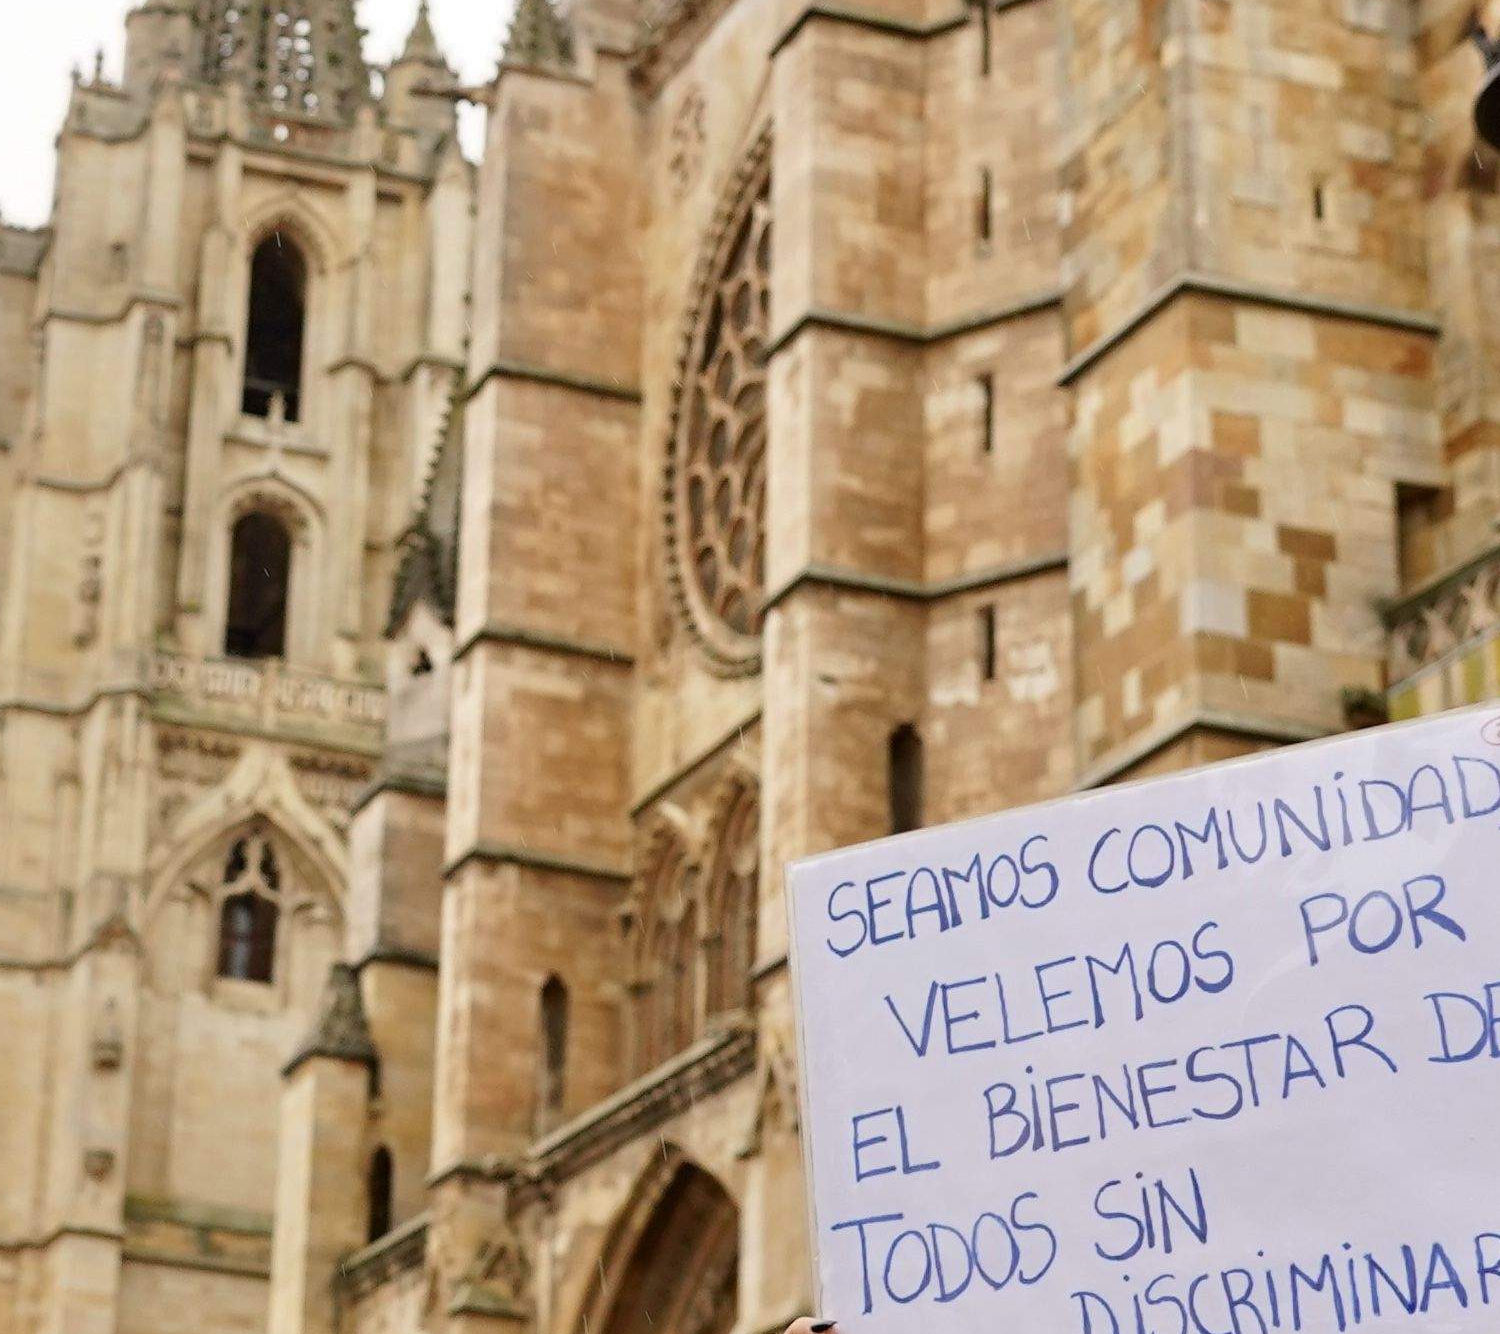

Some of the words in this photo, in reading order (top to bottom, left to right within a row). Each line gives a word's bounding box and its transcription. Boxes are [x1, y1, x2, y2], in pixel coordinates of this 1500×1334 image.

[826, 834, 1060, 958] SEAMOS
[884, 921, 1236, 1058] VELEMOS
[1298, 873, 1468, 966] POR
[852, 1107, 941, 1183] EL
[982, 1003, 1399, 1160] BIENESTAR
[832, 1191, 1058, 1315] TODOS
[1094, 1167, 1208, 1263] SIN
